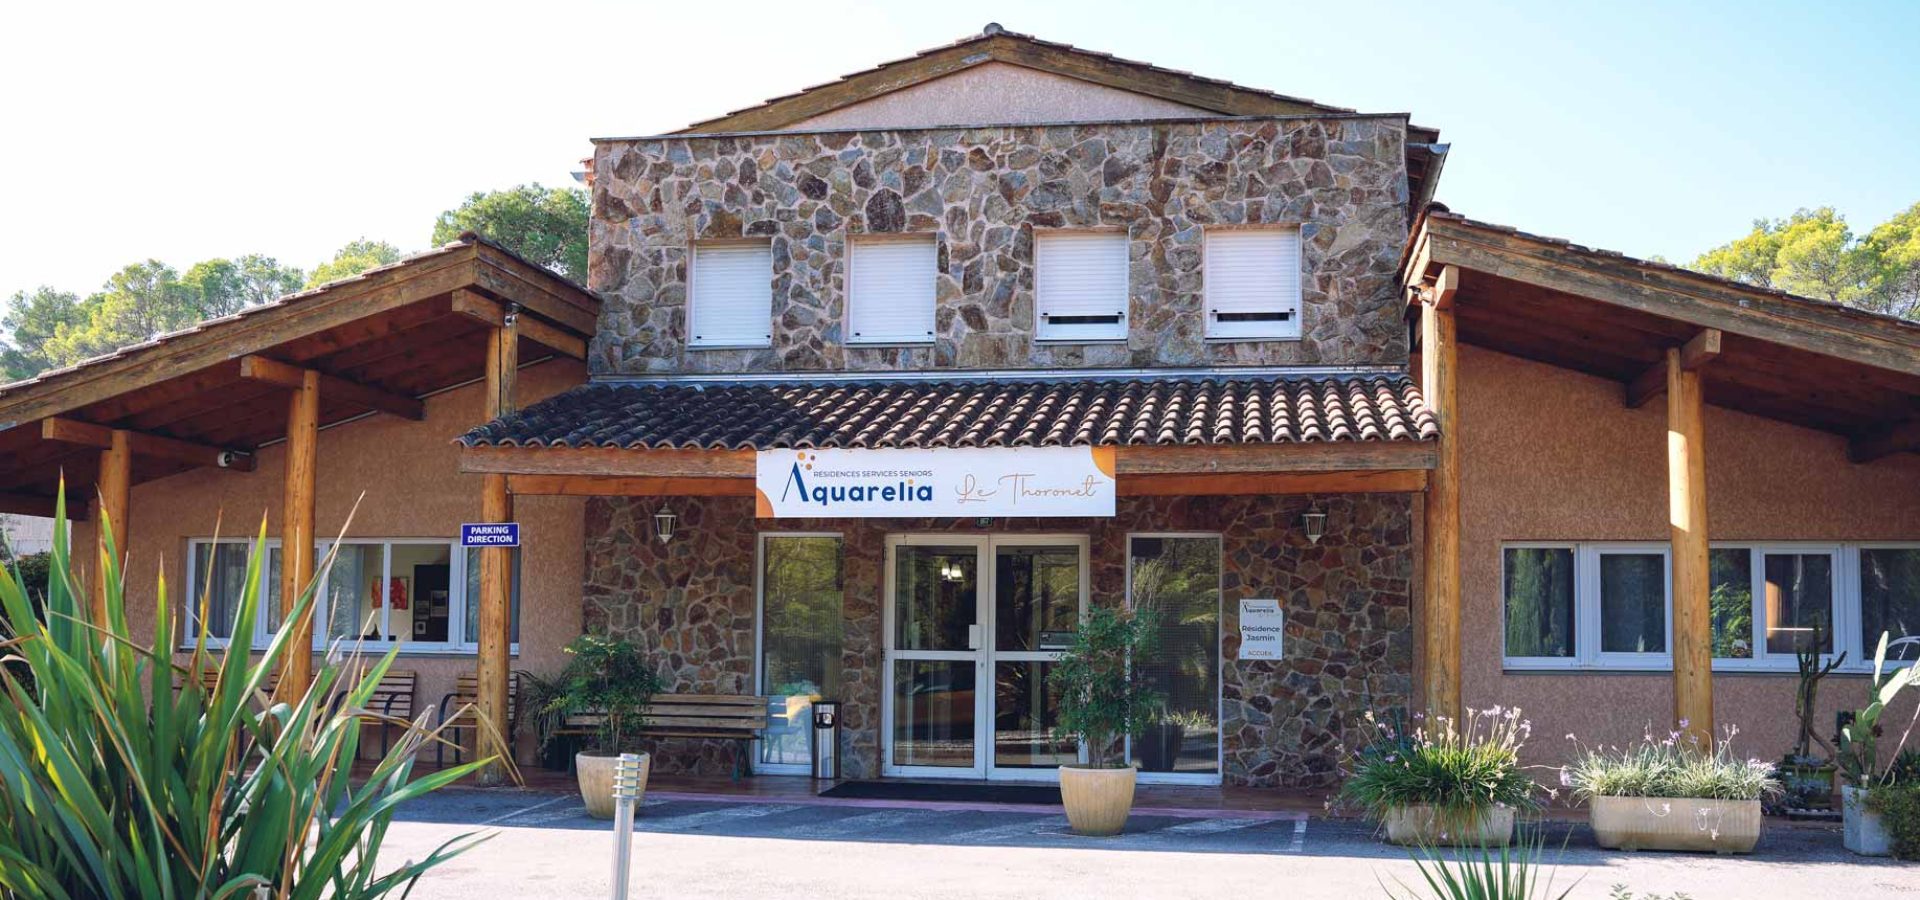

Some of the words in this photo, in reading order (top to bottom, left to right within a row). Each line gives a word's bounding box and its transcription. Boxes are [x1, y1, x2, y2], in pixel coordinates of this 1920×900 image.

[781, 461, 933, 506] Aquarelia
[955, 473, 997, 504] Le
[998, 472, 1103, 505] Thoronet
[467, 535, 513, 543] DIRECTION
[471, 526, 509, 534] PARKING
